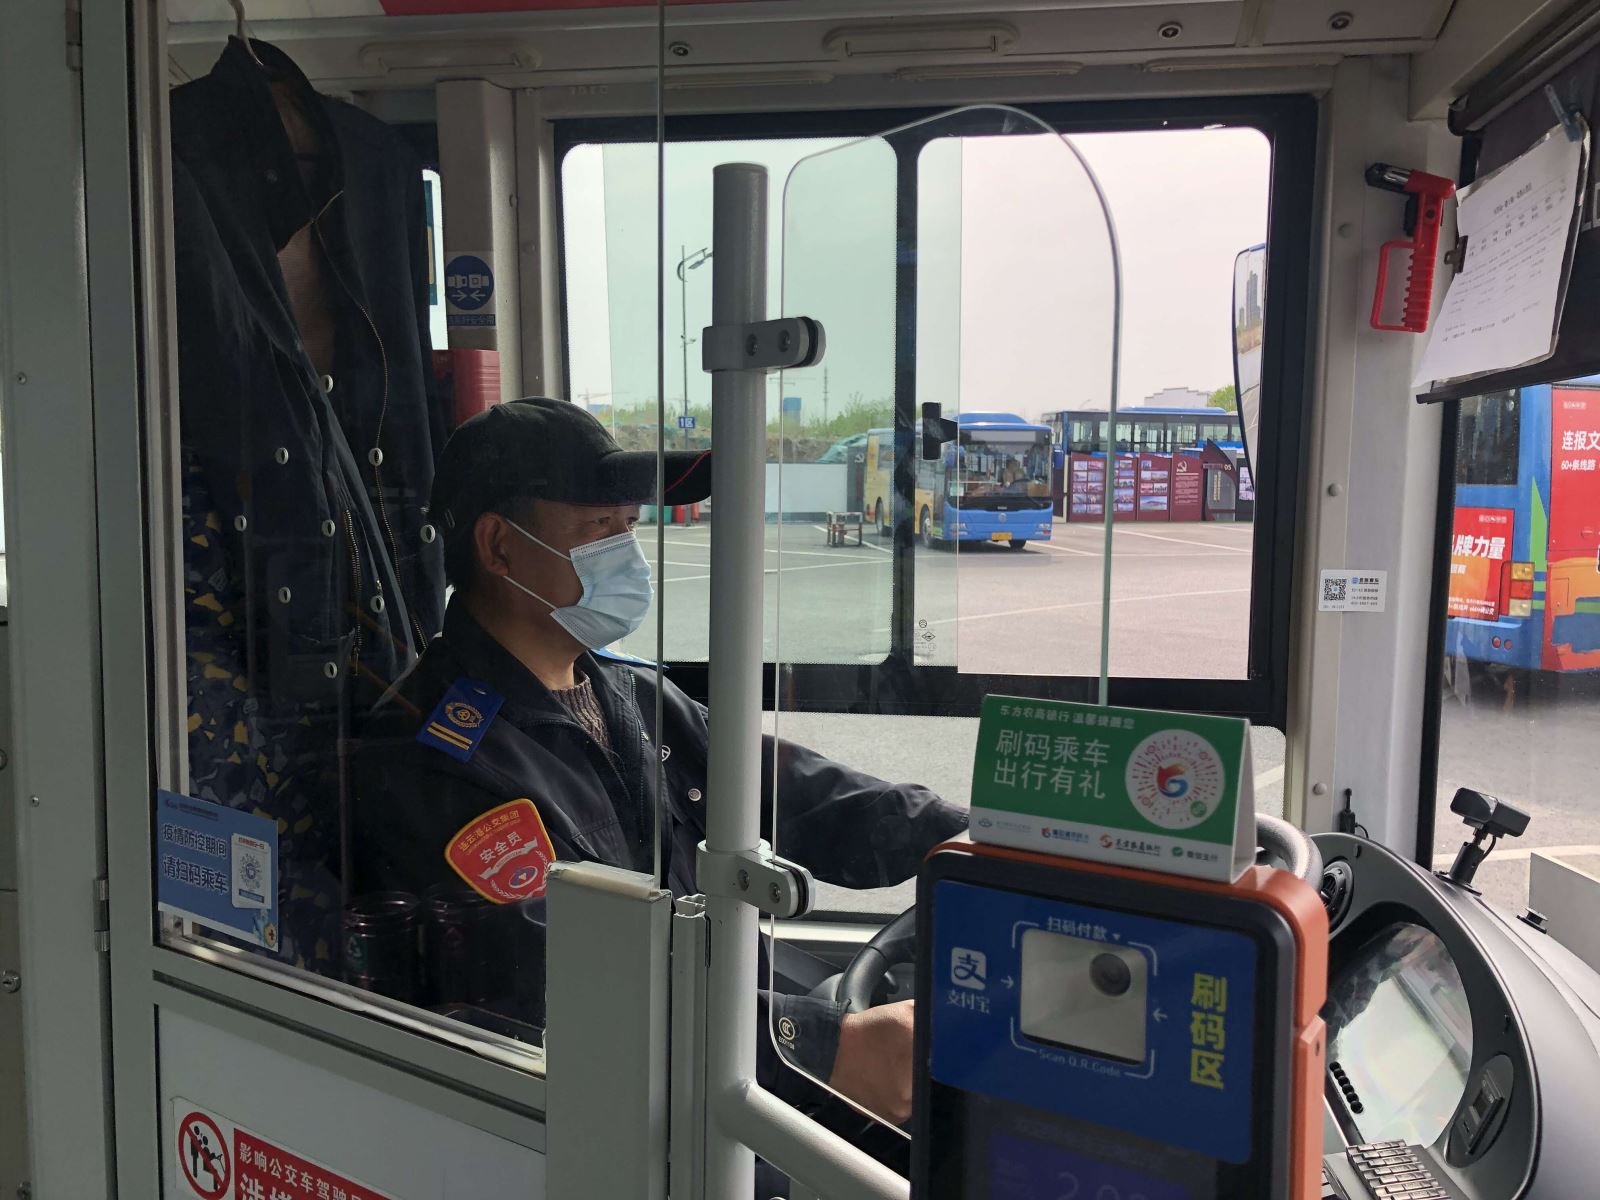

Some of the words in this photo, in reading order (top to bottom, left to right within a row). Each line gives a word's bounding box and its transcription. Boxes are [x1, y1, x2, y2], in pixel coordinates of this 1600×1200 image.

[680, 417, 694, 428] 1区
[1561, 430, 1600, 451] 连报文
[1452, 534, 1505, 559] 牌力量
[996, 729, 1110, 767] 刷码乘车
[993, 759, 1106, 799] 出行有礼
[163, 823, 227, 858] 疫情防控期间
[458, 810, 520, 852] 连云港公交集团
[480, 832, 522, 863] 安全员
[163, 855, 229, 895] 请扫码乘车
[1047, 917, 1108, 941] 扫码付款
[947, 989, 991, 1014] 支付宝
[1190, 972, 1228, 1090] 刷码区
[1039, 1048, 1066, 1066] Scan
